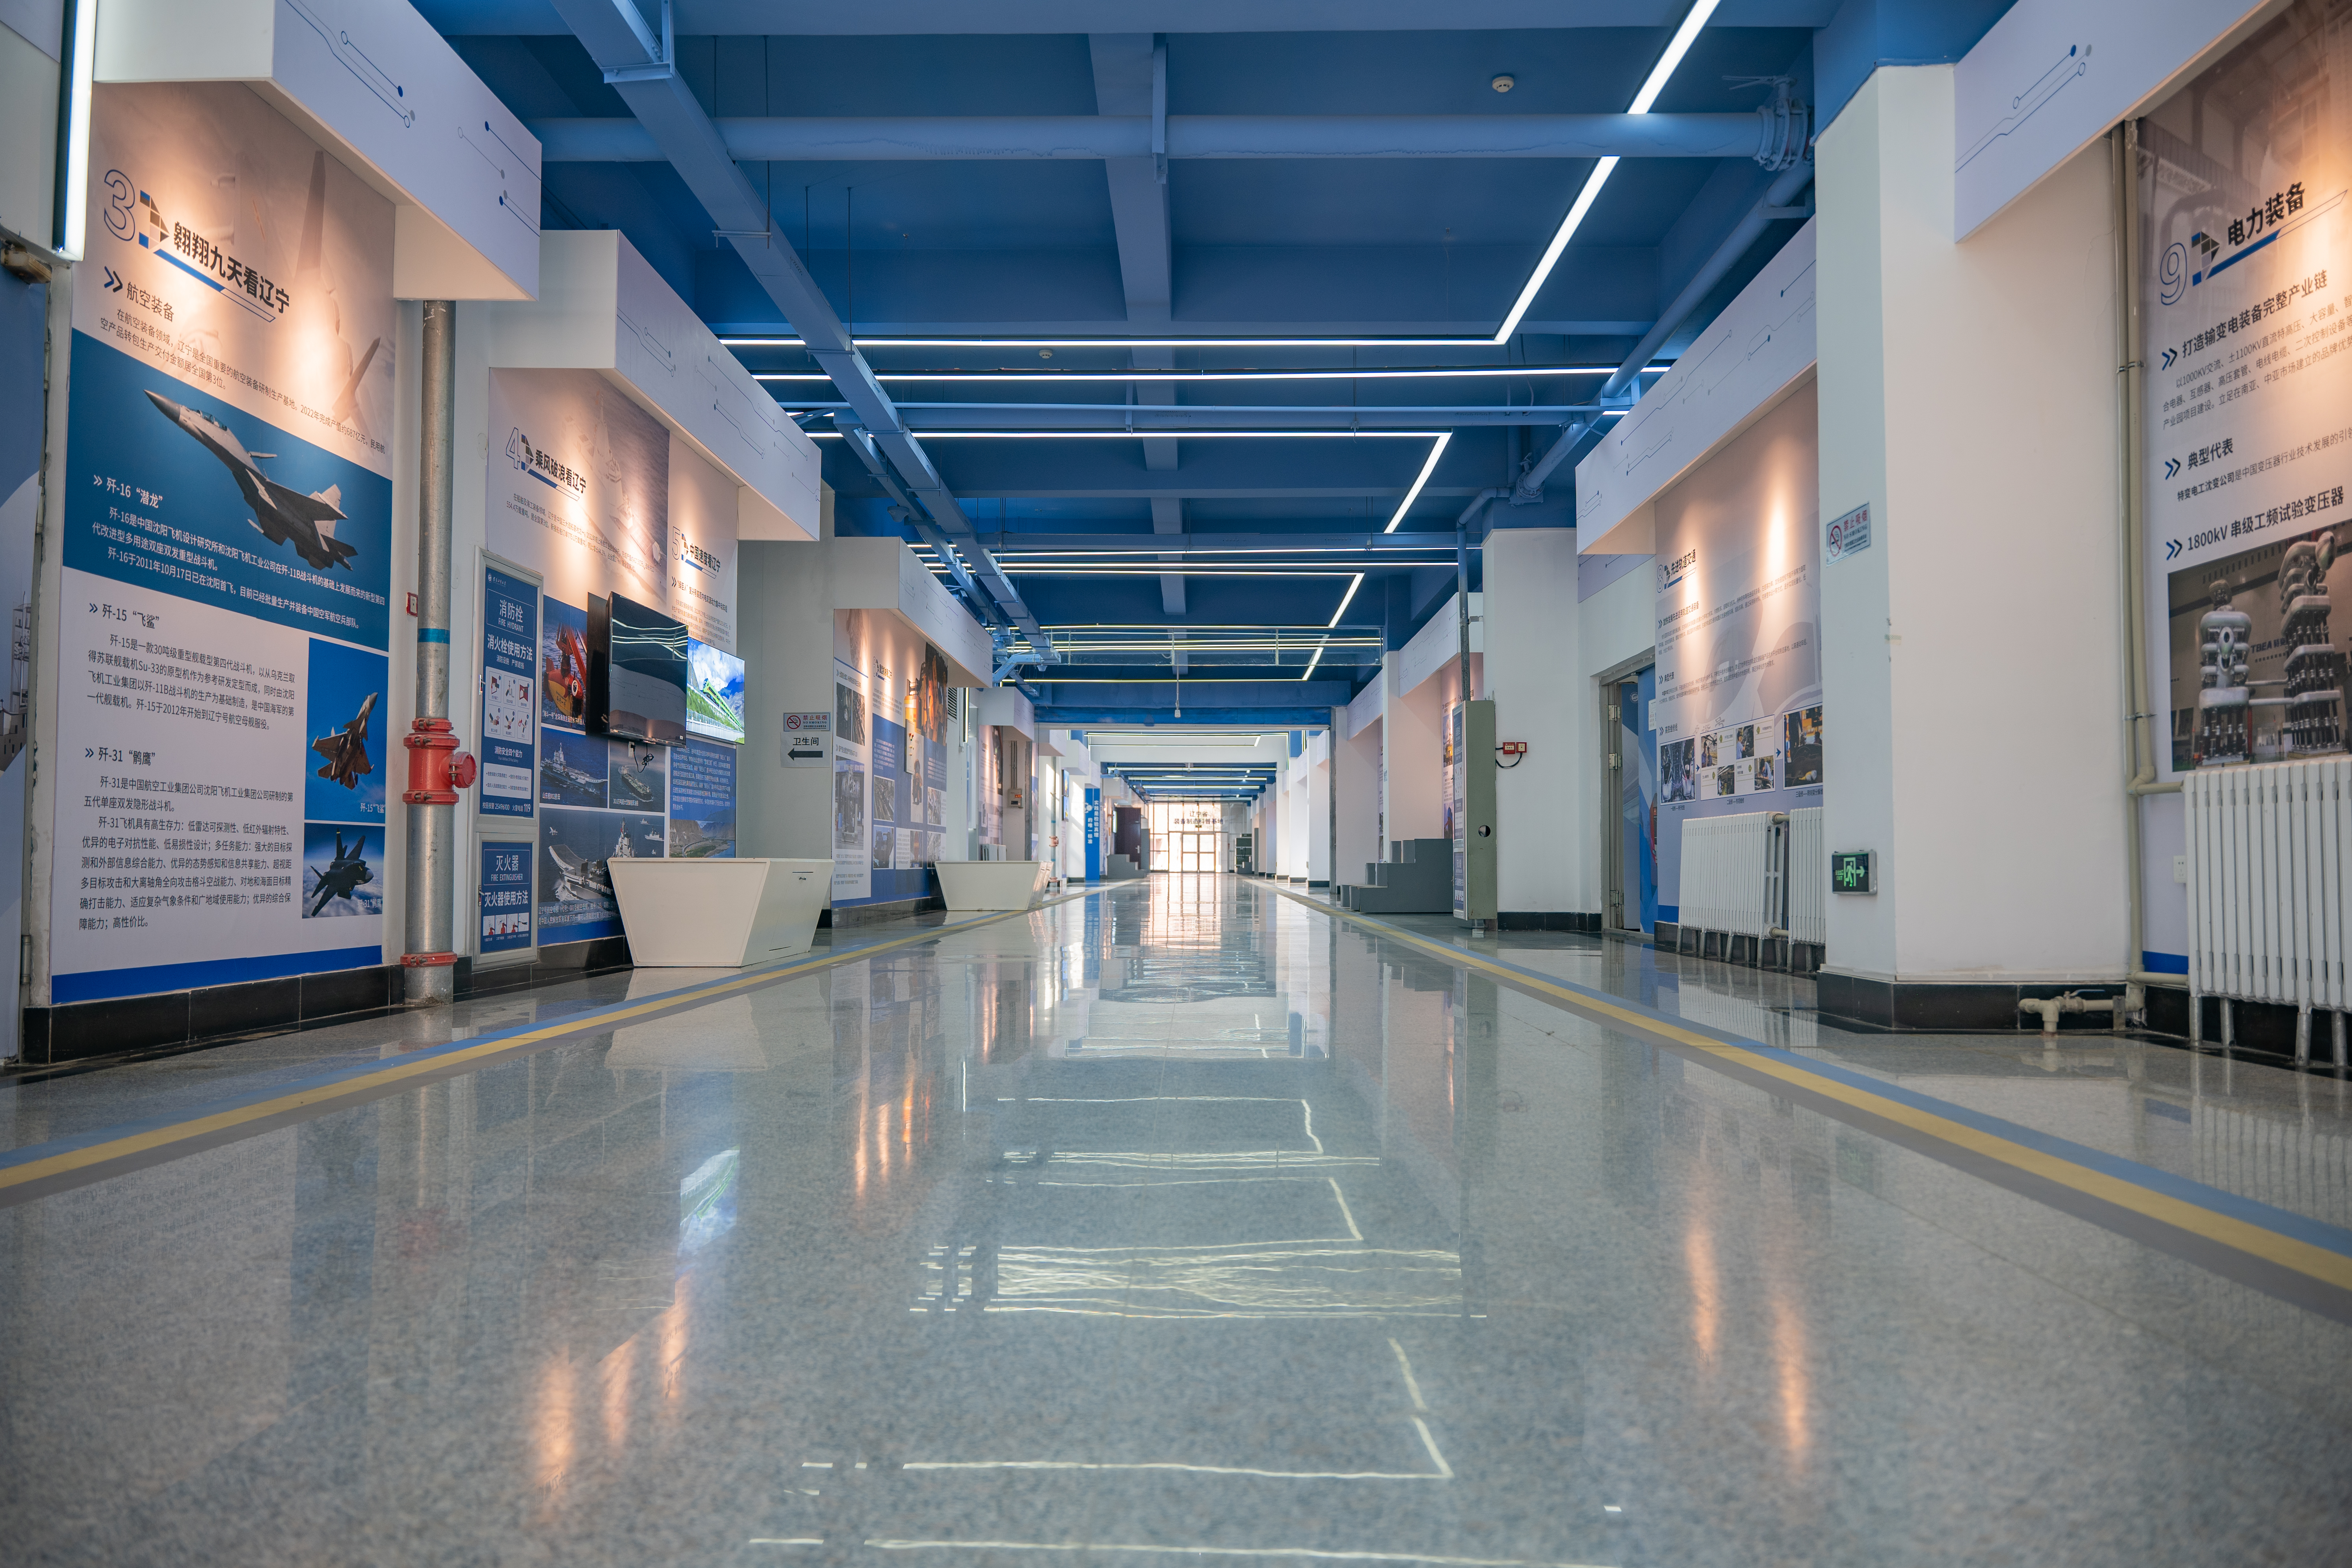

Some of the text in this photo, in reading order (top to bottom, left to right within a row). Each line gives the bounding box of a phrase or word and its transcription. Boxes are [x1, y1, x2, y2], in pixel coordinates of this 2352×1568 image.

[104, 169, 135, 241] 3
[2228, 182, 2305, 246] 电力装备
[173, 221, 290, 313] 翱翔九天看辽宁
[2160, 243, 2187, 305] 9
[127, 282, 174, 322] 航空装备
[2182, 270, 2327, 358] 打造输变电装备完整产业链
[100, 318, 226, 390] 空产品转包生产交付金额居全国第3位。
[506, 427, 520, 470] 4
[2188, 438, 2233, 470] 典型代表
[535, 449, 586, 493] 乘风破浪看辽宁
[1843, 510, 1867, 532] 禁止吸烟
[1849, 524, 1867, 537] SMOKING
[2188, 486, 2344, 551] 1800kV 串级工频试验变压器
[92, 522, 218, 571] 代改进型多用途双座双发重型战斗机。
[672, 526, 680, 560] 5
[690, 544, 721, 572] 中国速度看辽宁
[1671, 549, 1696, 576] 先进轨道交通
[1657, 565, 1663, 593] 8
[500, 600, 523, 622] 消防栓
[507, 621, 524, 632] HYDRANT
[110, 634, 295, 683] 歼-15是一款30吨级重型舰载型第四代战斗机，以从乌克兰取
[487, 634, 533, 662] 消火栓使用方法
[496, 654, 524, 669] 消防设施 严禁遮挡
[88, 650, 295, 700] 得苏联舰载机Su-33的原型机作为参考研发定型而成，同时由沈阳
[1664, 672, 1674, 682] 典型代表
[88, 671, 294, 716] 飞机工业集团以歼-11B战斗机的生产为基础制造，是中国海军的第
[87, 692, 269, 730] 一代舰载机。歼-15于2012年开始到辽宁号航空母舰服役。
[494, 746, 523, 758] 消防安全四个能力
[793, 737, 819, 746] 卫生间
[100, 776, 293, 802] 歼-31是中国航空工业集团公司沈阳飞机工业集团公司研制的第
[84, 795, 175, 812] 五代单座双发隐形战斗机。
[98, 816, 289, 835] 歼-31飞机具有高生存力：低雷达可探测性、低红外辐射特性、
[82, 836, 292, 852] 优异的电子对抗性能、低易损性设计；多任务能力：强大的目标探
[81, 856, 292, 869] 测和外部信息综合能力、优异的态势感知和信息共享能力、超视距
[496, 855, 519, 871] 灭火器
[81, 876, 292, 889] 多目标攻击和大离轴角全向攻击格斗空战能力、对地和海面目标精
[80, 893, 291, 910] 确打击能力、适应复杂气象条件和广地域使用能力；优异的综合保
[485, 890, 528, 907] 灭火器使用方法
[79, 915, 148, 930] 障能力；高性价比。
